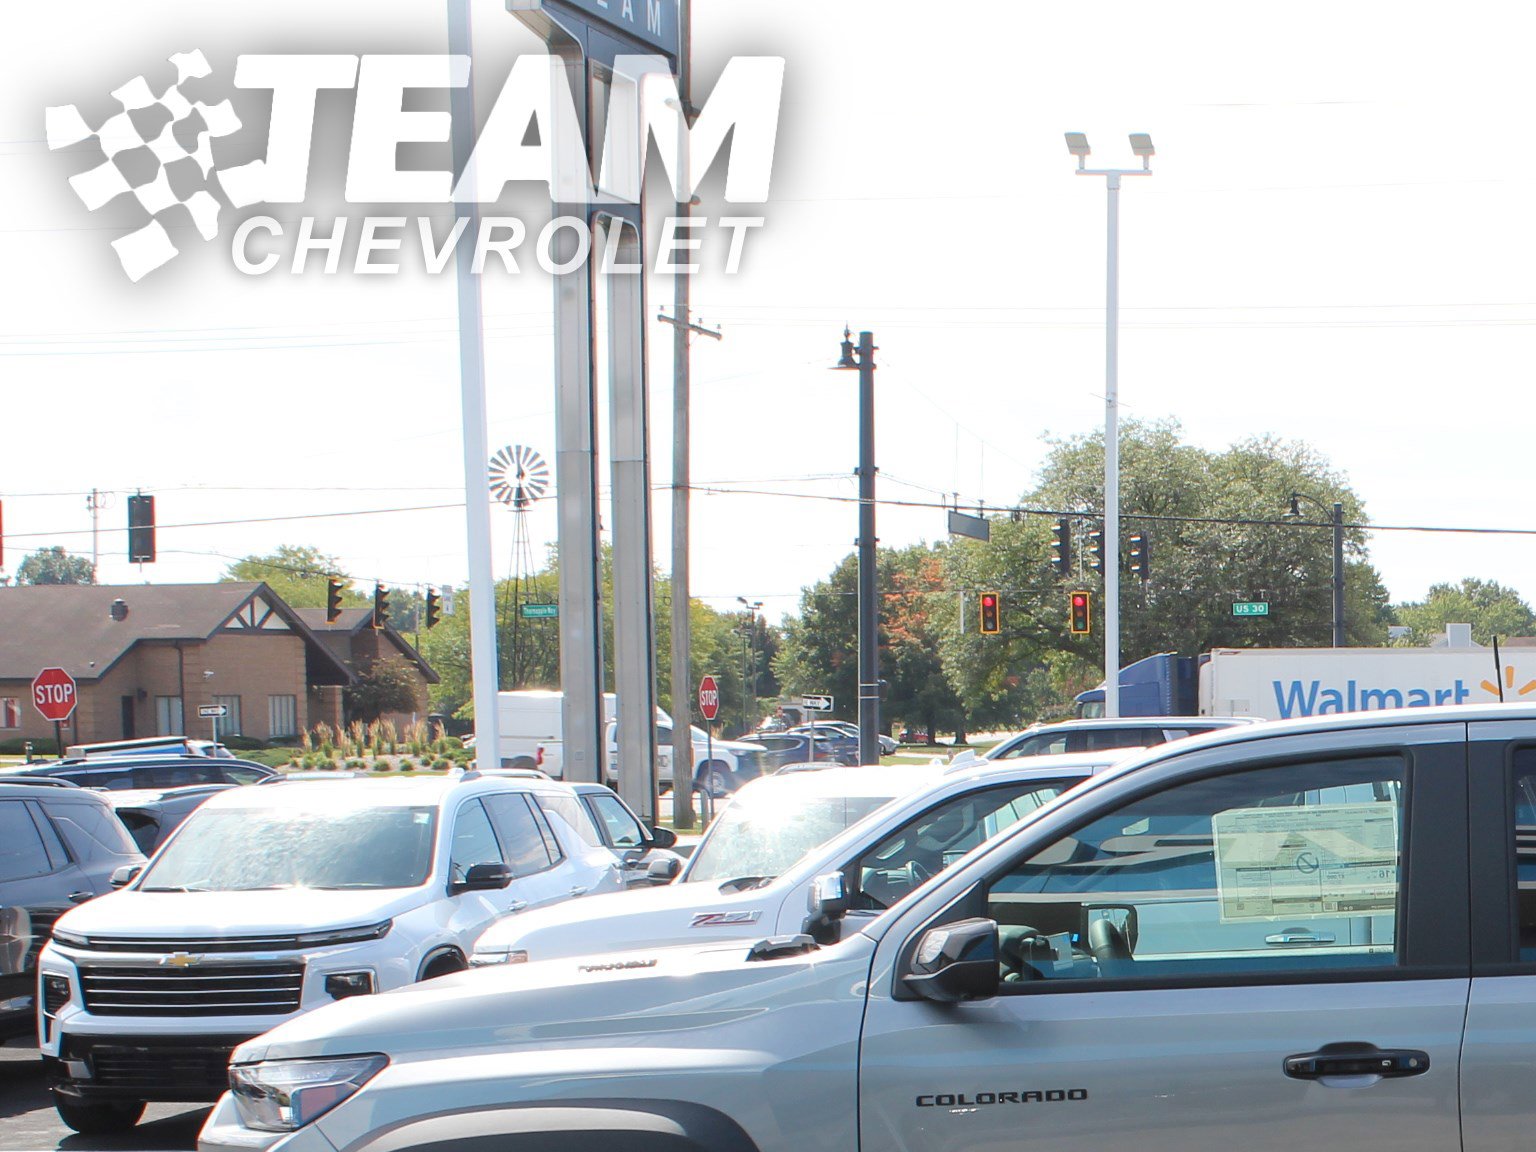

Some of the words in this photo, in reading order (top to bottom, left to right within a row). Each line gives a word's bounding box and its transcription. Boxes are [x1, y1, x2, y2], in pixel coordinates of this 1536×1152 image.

[597, 0, 661, 37] AM
[1236, 605, 1249, 613] US
[1252, 605, 1265, 613] 30
[36, 683, 73, 704] STOP
[701, 690, 717, 706] STOP
[1273, 680, 1469, 719] Walmart
[916, 1088, 1088, 1107] COLORADO
